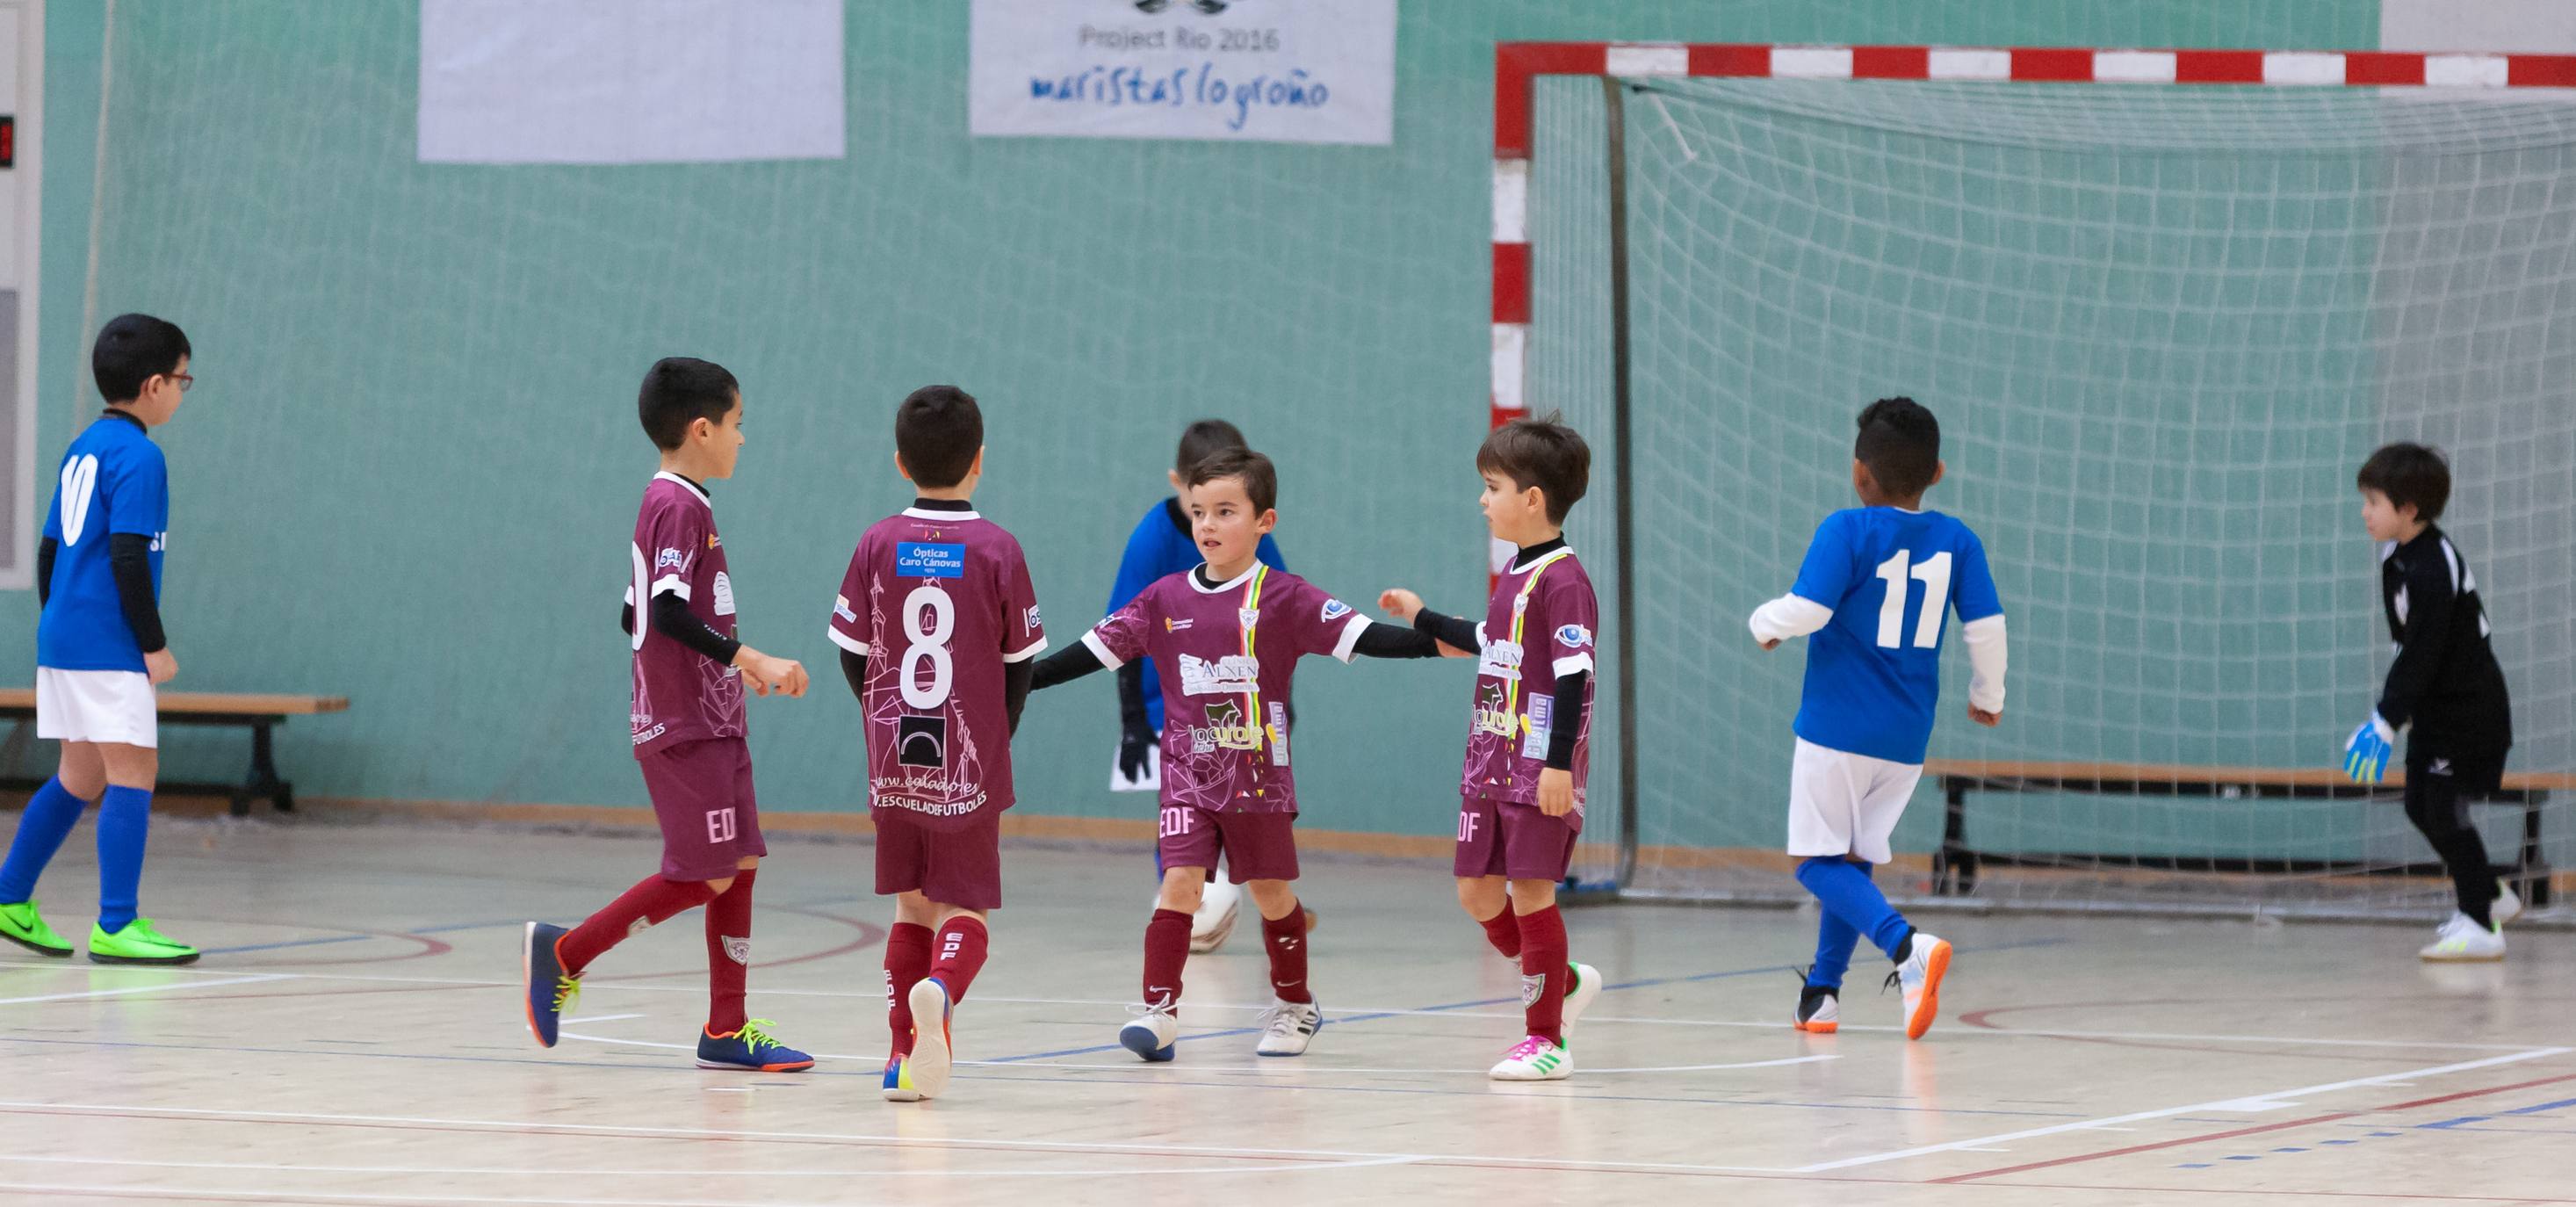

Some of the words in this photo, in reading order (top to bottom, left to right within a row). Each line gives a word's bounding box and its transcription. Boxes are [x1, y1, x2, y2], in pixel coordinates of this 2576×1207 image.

[1079, 25, 1165, 51] Project
[1175, 25, 1211, 50] Rio
[1219, 27, 1280, 51] 2016
[61, 453, 98, 546] 10
[899, 557, 920, 567] Caro
[923, 557, 962, 568] Cánovas
[913, 546, 949, 560] Ópticas
[1876, 549, 1952, 648] 11
[899, 586, 955, 710] 8
[1159, 806, 1194, 839] EDF
